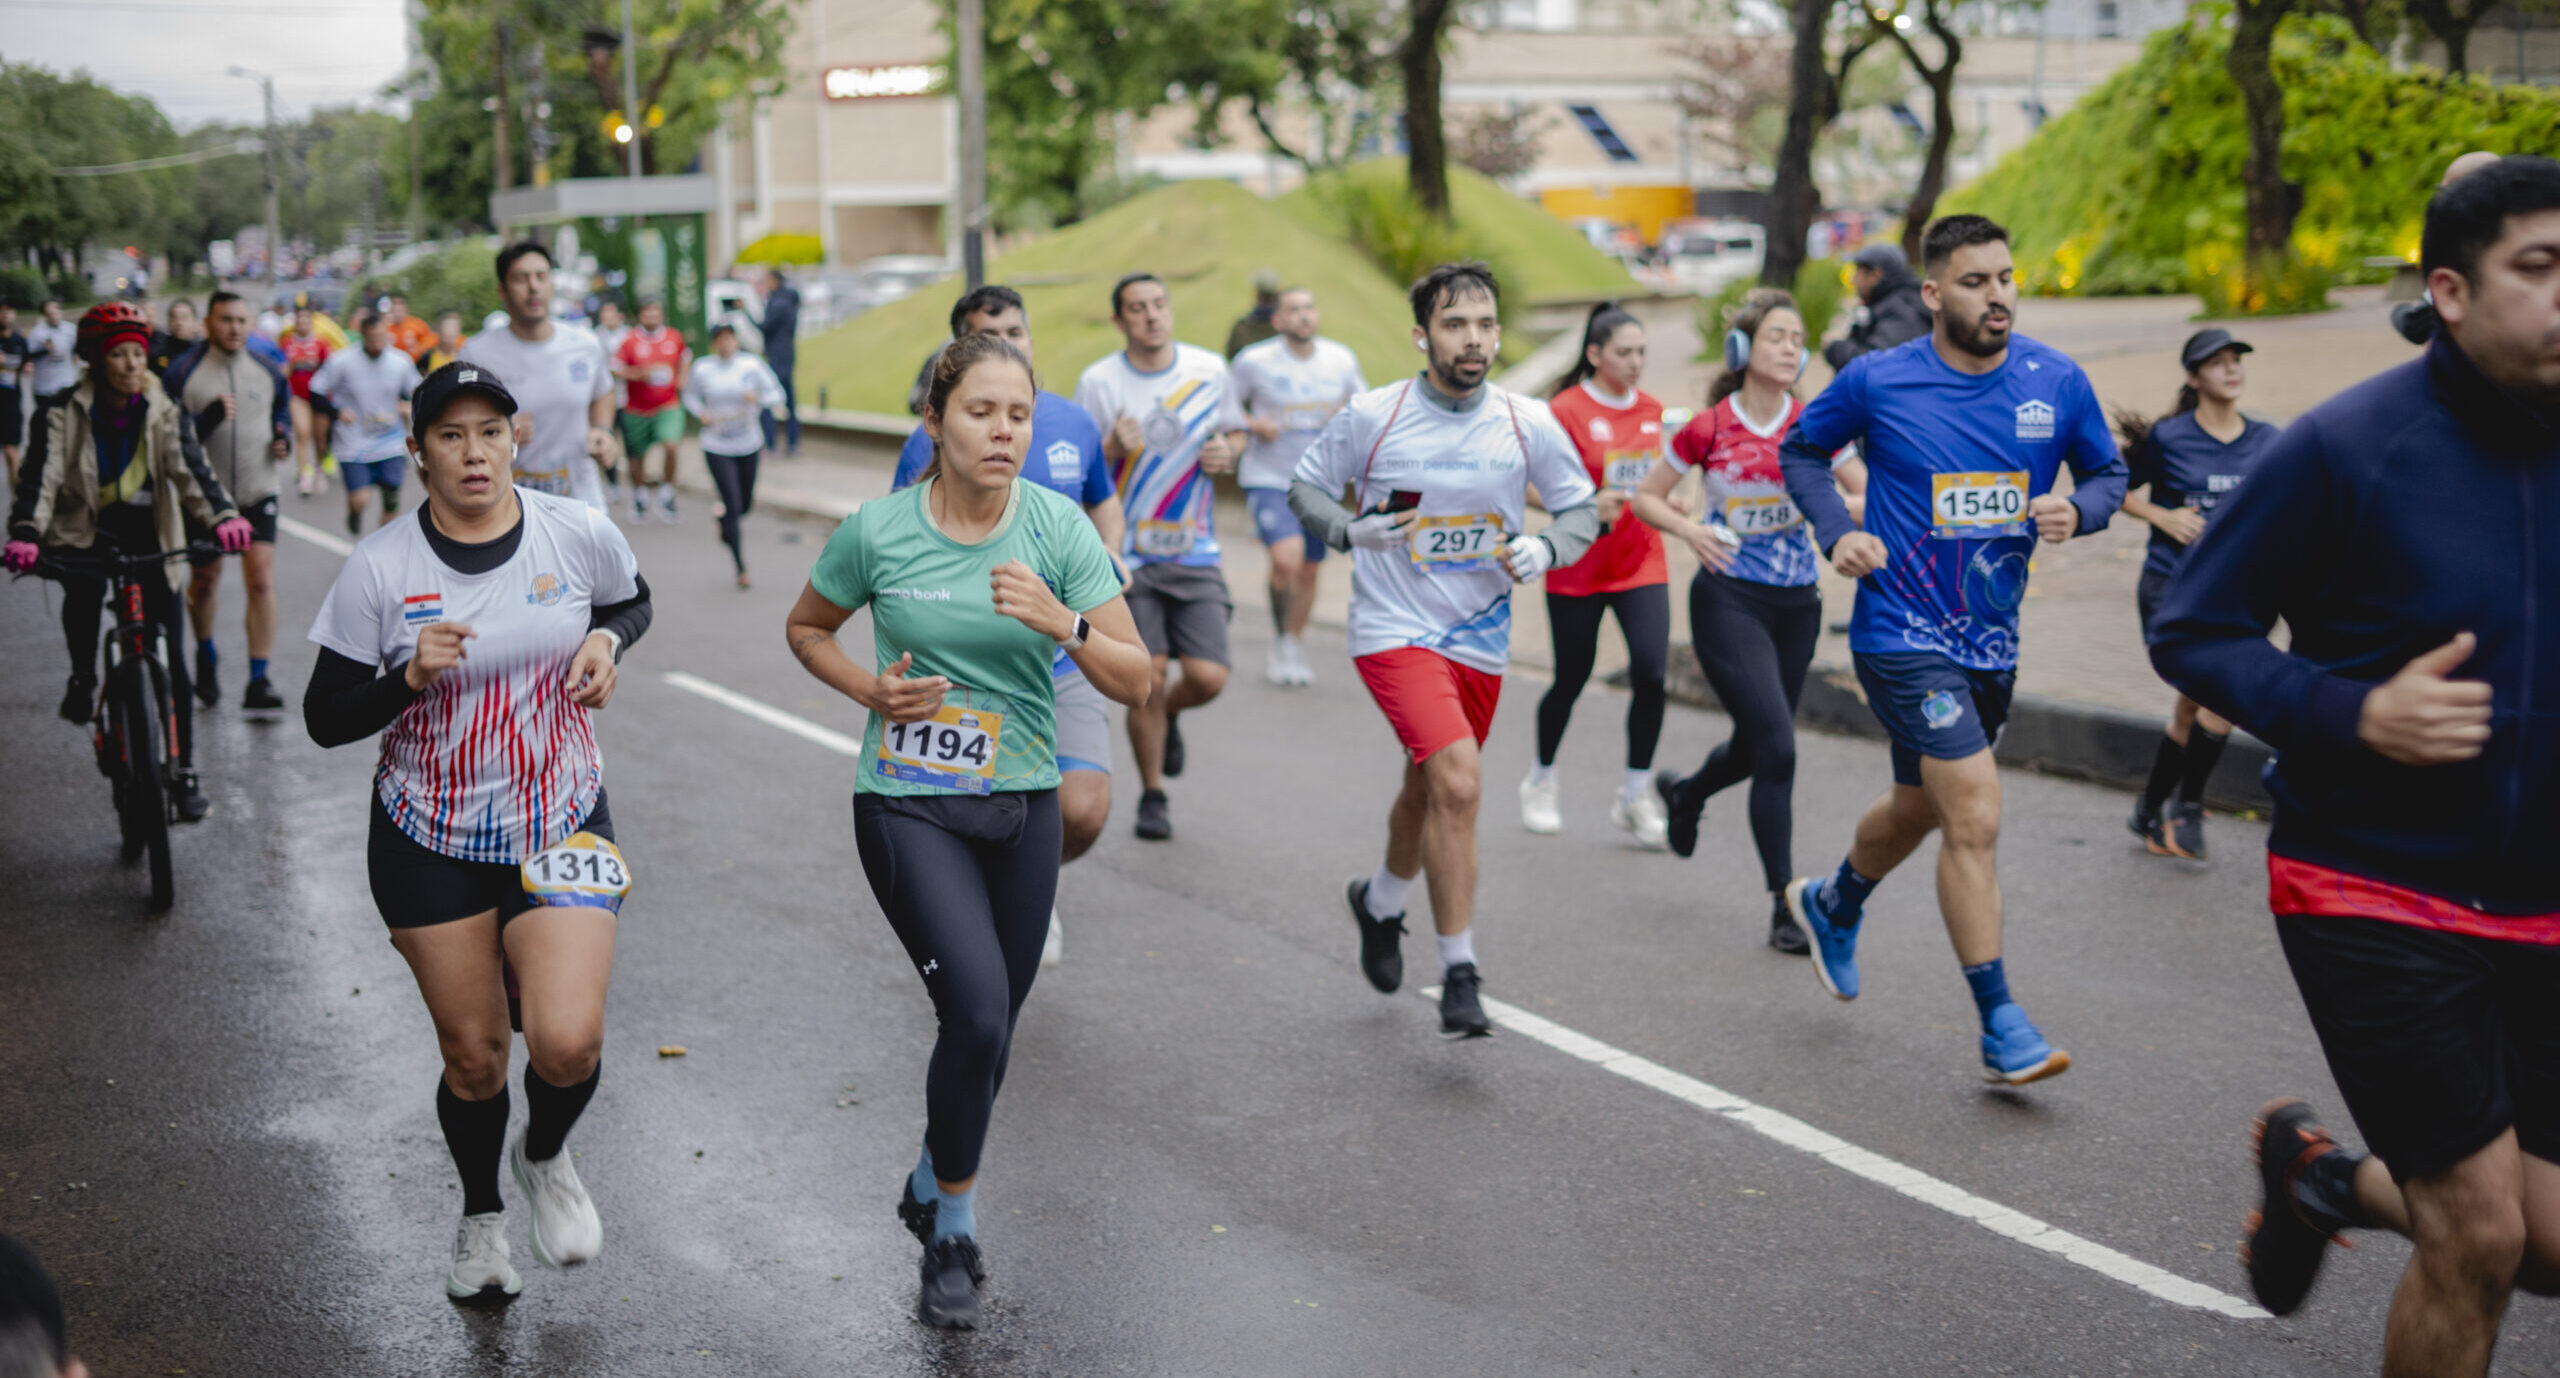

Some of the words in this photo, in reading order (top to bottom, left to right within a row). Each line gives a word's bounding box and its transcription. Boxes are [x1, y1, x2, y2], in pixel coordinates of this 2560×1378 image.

[1422, 459, 1479, 472] personal
[1943, 489, 2020, 517] 1540
[1742, 506, 1790, 529] 758
[1429, 528, 1486, 553] 297
[913, 588, 951, 601] bank
[890, 724, 987, 766] 1194
[533, 852, 624, 887] 1313
